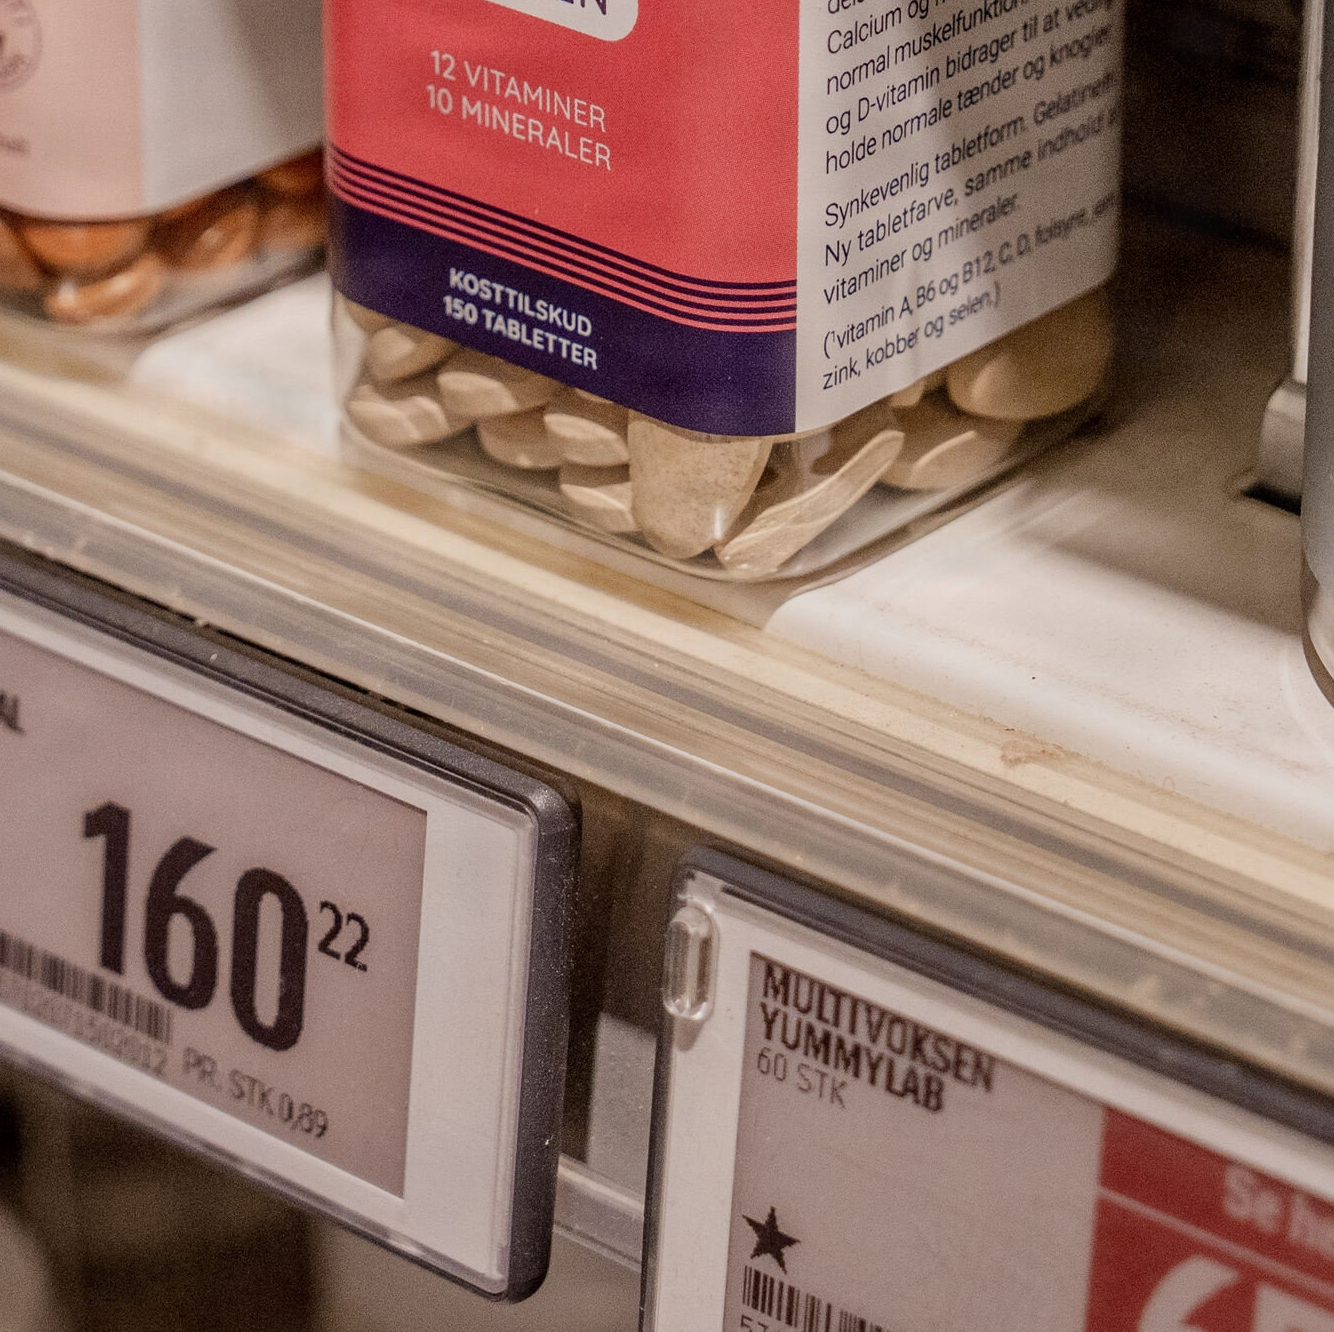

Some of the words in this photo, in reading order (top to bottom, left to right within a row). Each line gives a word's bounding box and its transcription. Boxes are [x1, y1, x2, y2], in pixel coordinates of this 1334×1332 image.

[827, 7, 903, 55] Calcium
[431, 50, 456, 81] 12
[464, 61, 606, 133] VITAMINER
[826, 109, 852, 137] og
[858, 66, 940, 122] D-vitamin
[946, 30, 1017, 80] bidrager
[1021, 16, 1038, 44] til
[1042, 7, 1060, 34] at
[827, 45, 891, 95] normal
[426, 85, 453, 115] 10
[461, 96, 612, 171] MINERALER
[825, 135, 877, 175] holde
[881, 98, 953, 149] normale
[957, 68, 1019, 111] tænder
[824, 162, 930, 229] Synkevenlig
[935, 115, 1027, 174] tabletform.
[825, 239, 852, 267] Ny
[857, 187, 959, 252] tabletfarve,
[964, 148, 1033, 198] samme
[449, 267, 593, 337] KOSTTILSKUD
[823, 249, 907, 305] vitaminer
[911, 237, 933, 263] og
[916, 282, 937, 310] B6
[442, 295, 478, 324] 150
[481, 309, 598, 371] TABLETTER
[822, 355, 861, 391] zink,
[865, 326, 919, 369] kobber
[83, 799, 309, 1052] 160
[316, 900, 371, 973] 22
[761, 1002, 945, 1114] YUMMYLAB
[764, 964, 995, 1094] MULTIVOKSEN
[182, 1046, 223, 1091] PR.
[758, 1047, 788, 1082] 60
[796, 1064, 850, 1110] STK
[1223, 1166, 1282, 1236] Se
